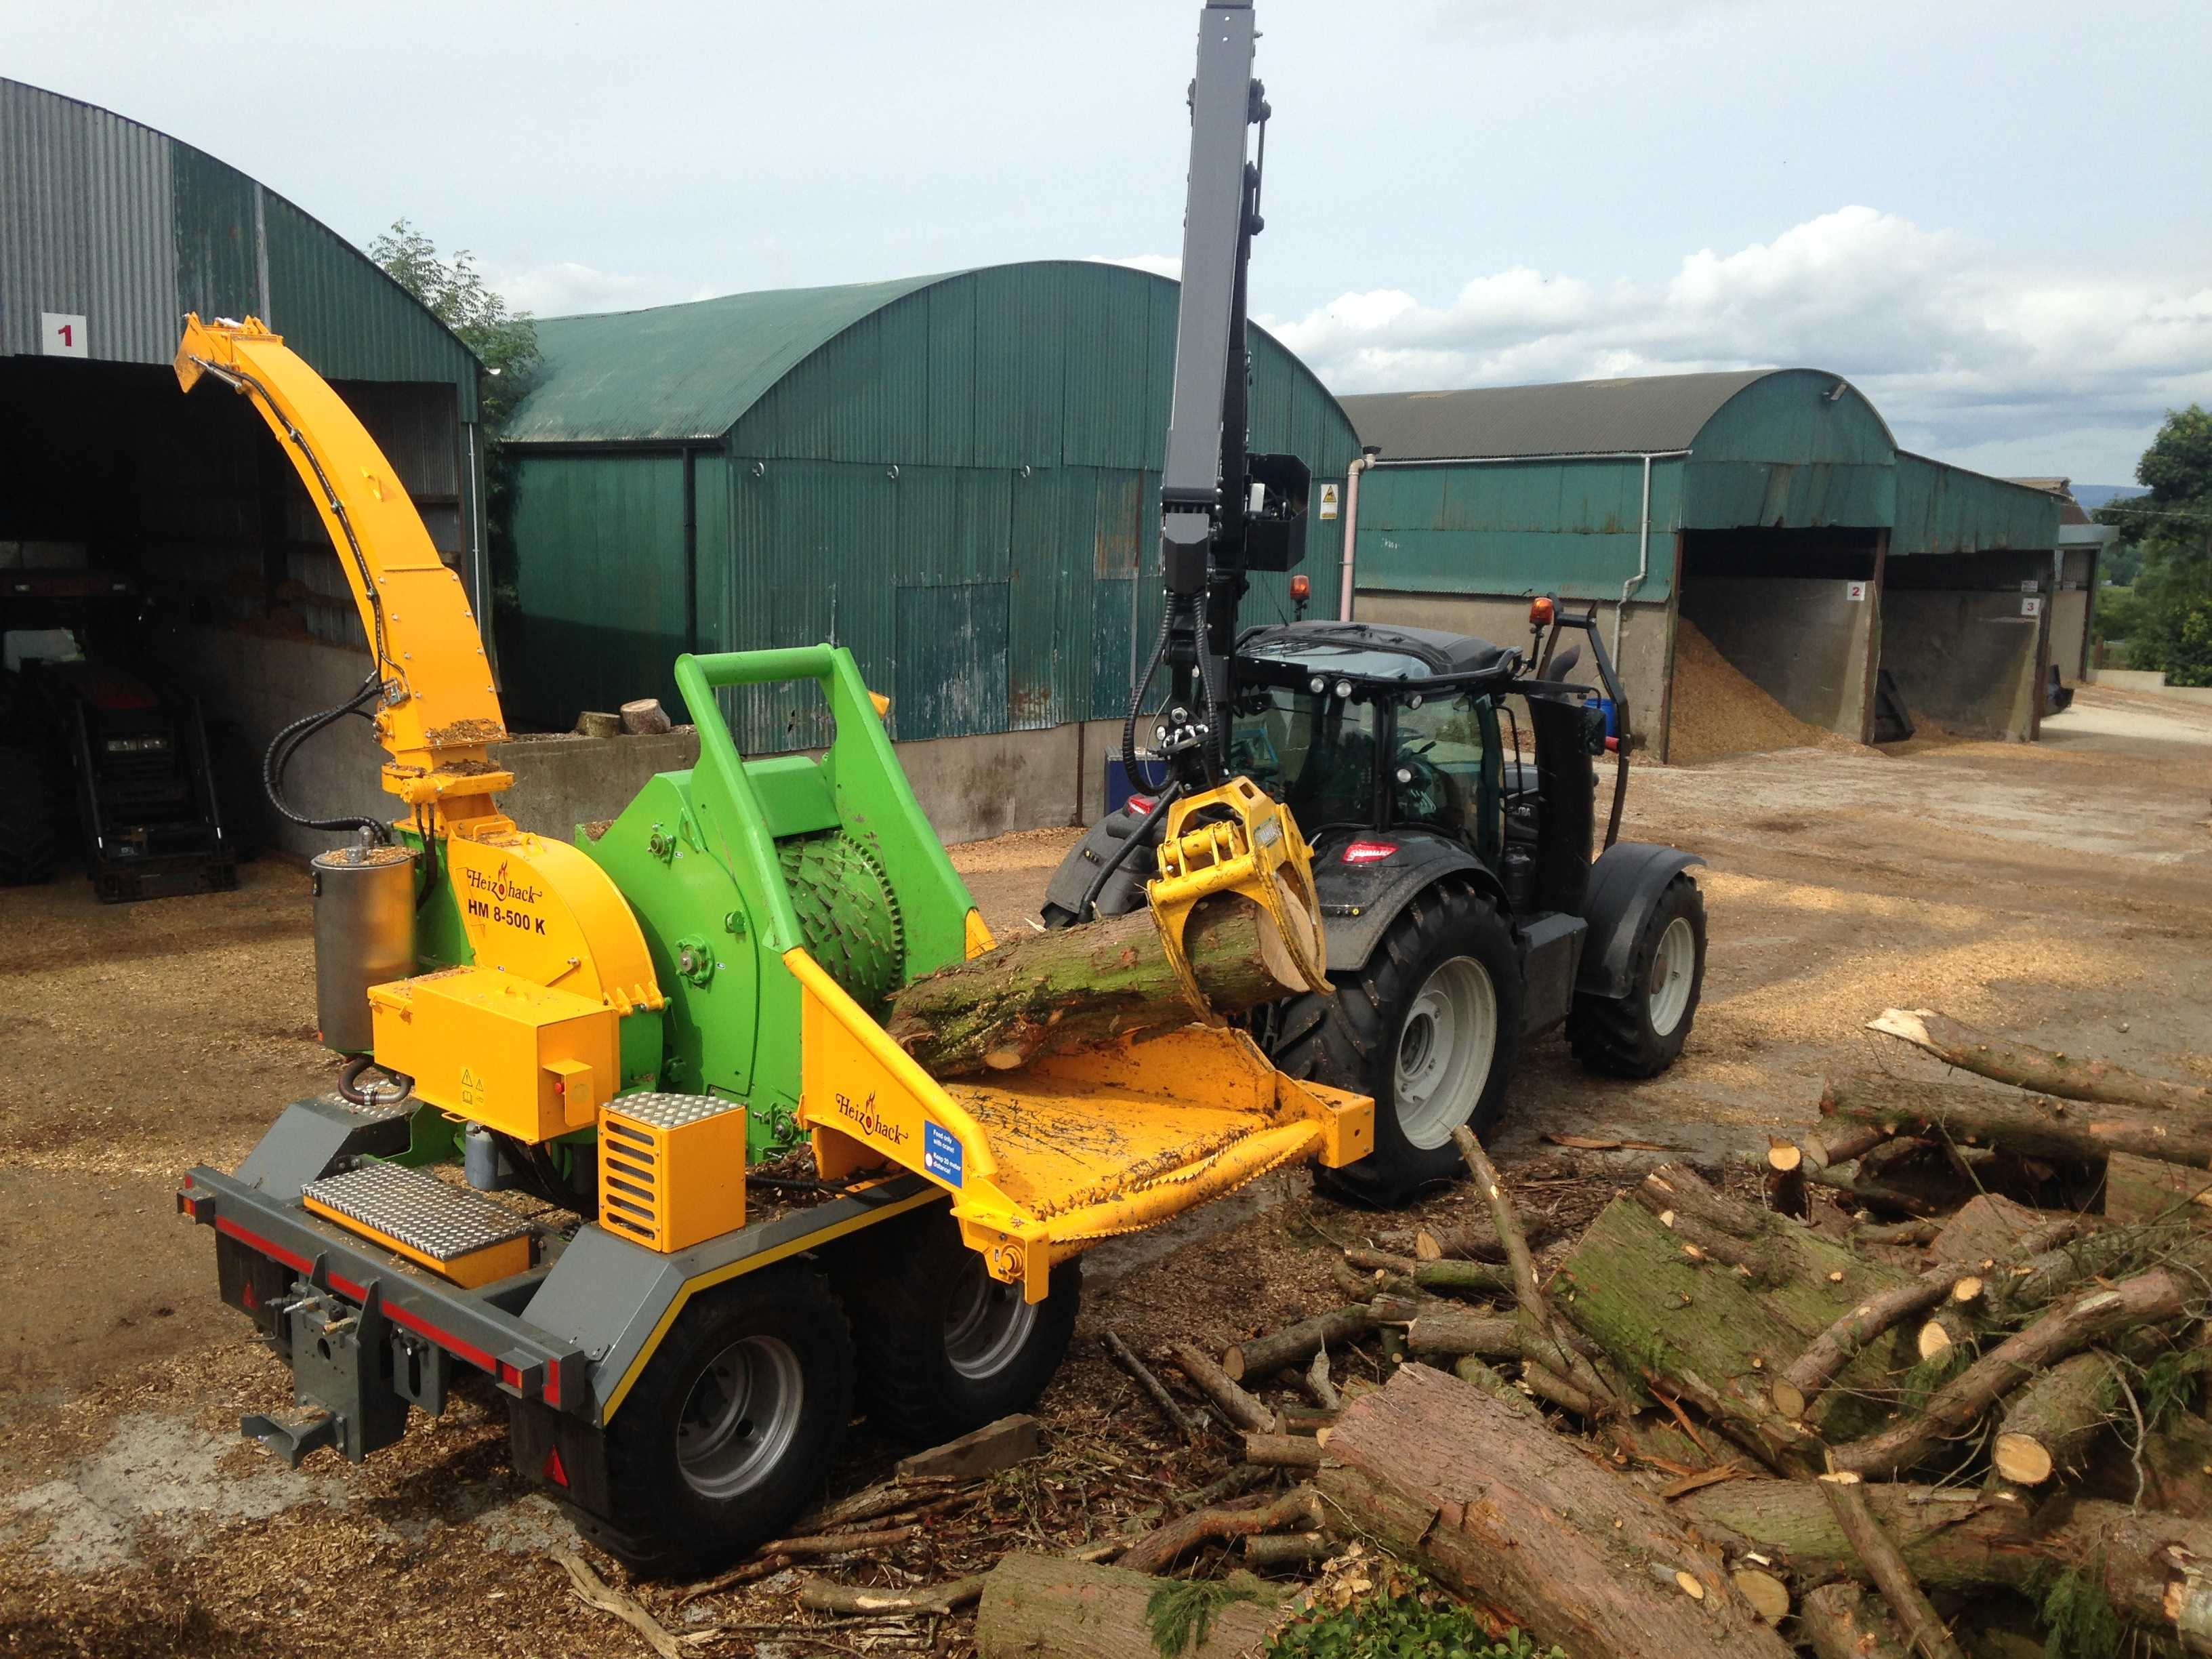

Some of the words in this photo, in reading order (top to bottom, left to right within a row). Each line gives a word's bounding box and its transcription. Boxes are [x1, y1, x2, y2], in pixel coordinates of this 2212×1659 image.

[58, 325, 72, 347] 1
[1852, 587, 1860, 596] 2
[2027, 602, 2034, 611] 3
[468, 899, 489, 918] HM
[493, 906, 531, 930] 8-500
[535, 918, 546, 936] K
[933, 1129, 943, 1139] Feed
[933, 1151, 944, 1164] Keep
